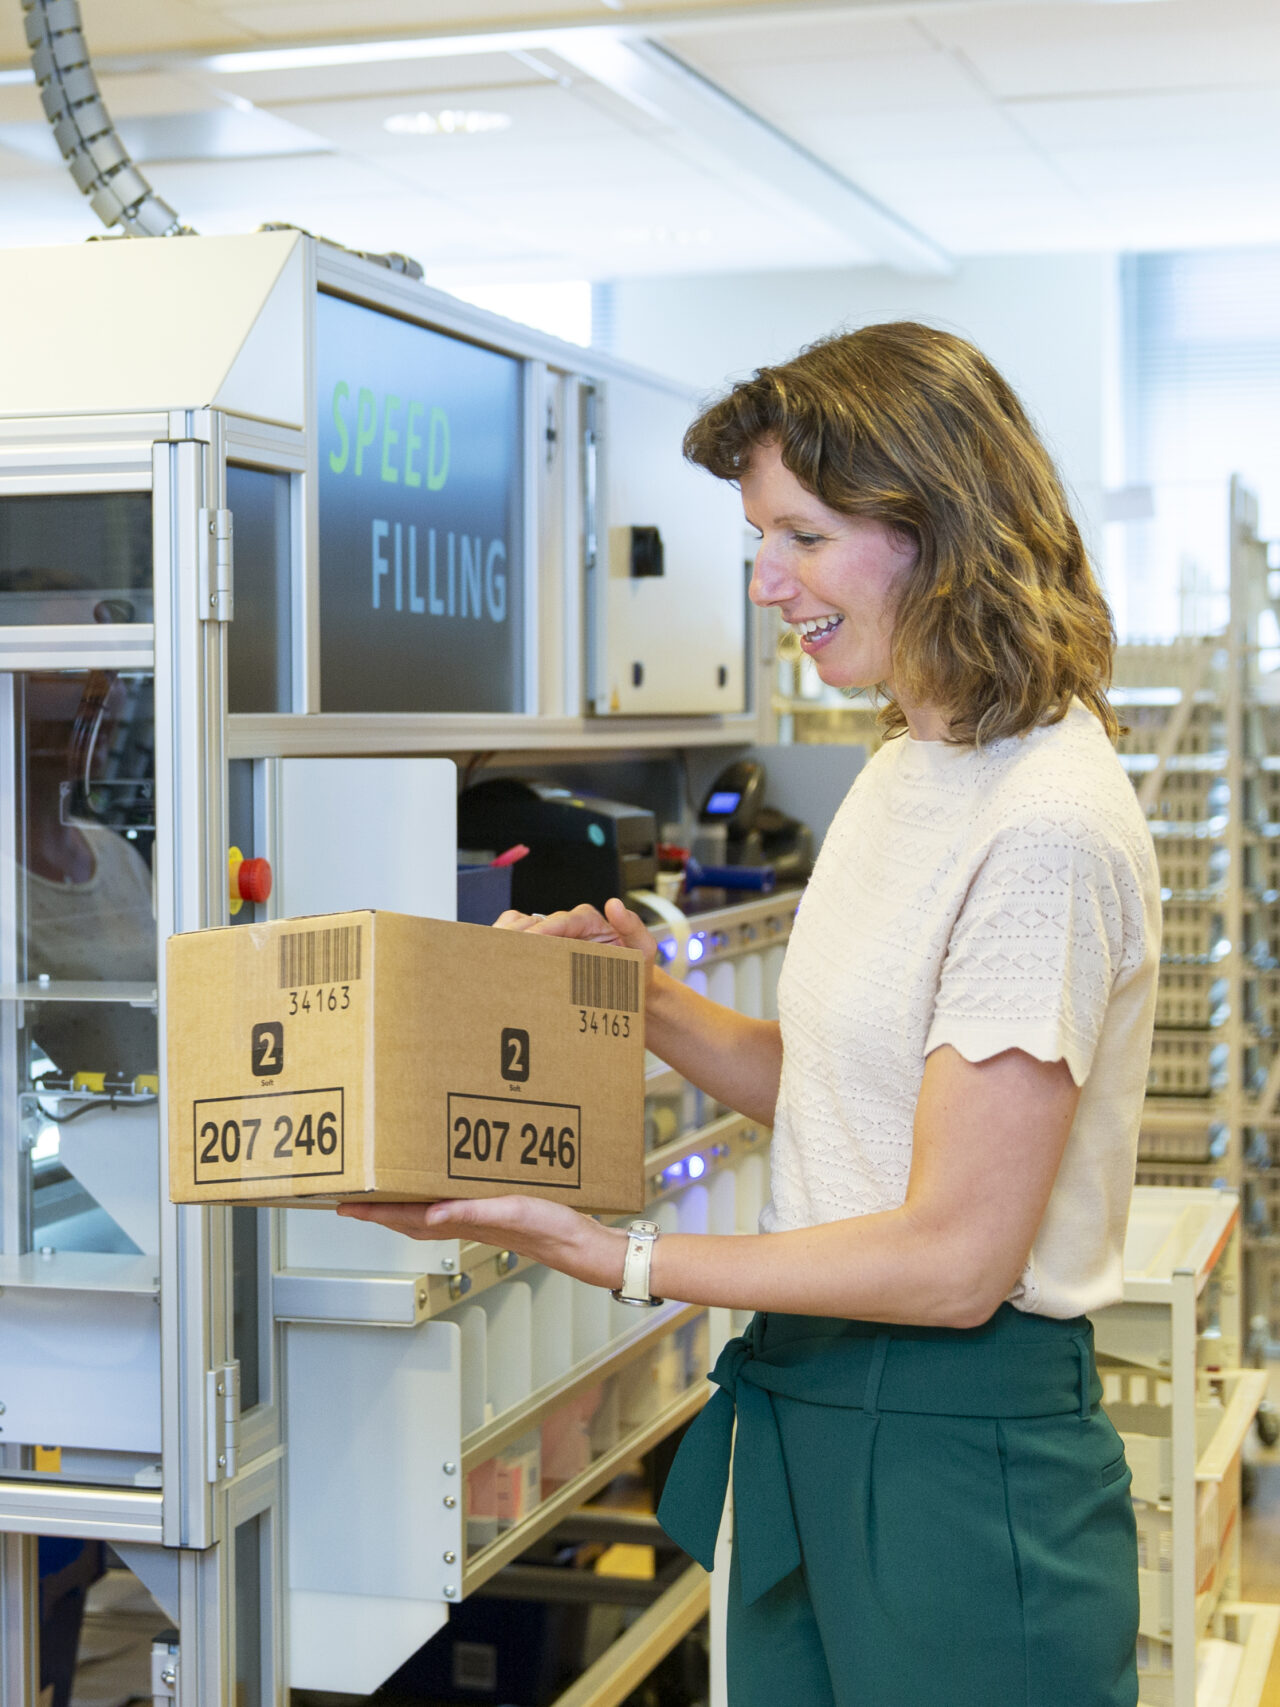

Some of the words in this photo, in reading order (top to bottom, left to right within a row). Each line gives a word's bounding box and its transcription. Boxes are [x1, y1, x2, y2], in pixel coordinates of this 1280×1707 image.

[329, 380, 450, 491] SPEED
[372, 519, 507, 623] FILLING
[288, 986, 351, 1016] 34163
[579, 1010, 631, 1038] 34163
[258, 1031, 277, 1067] 2
[507, 1037, 524, 1072] 2
[200, 1118, 262, 1164] 207
[273, 1111, 338, 1159] 246
[453, 1116, 510, 1162] 207
[520, 1123, 576, 1169] 246
